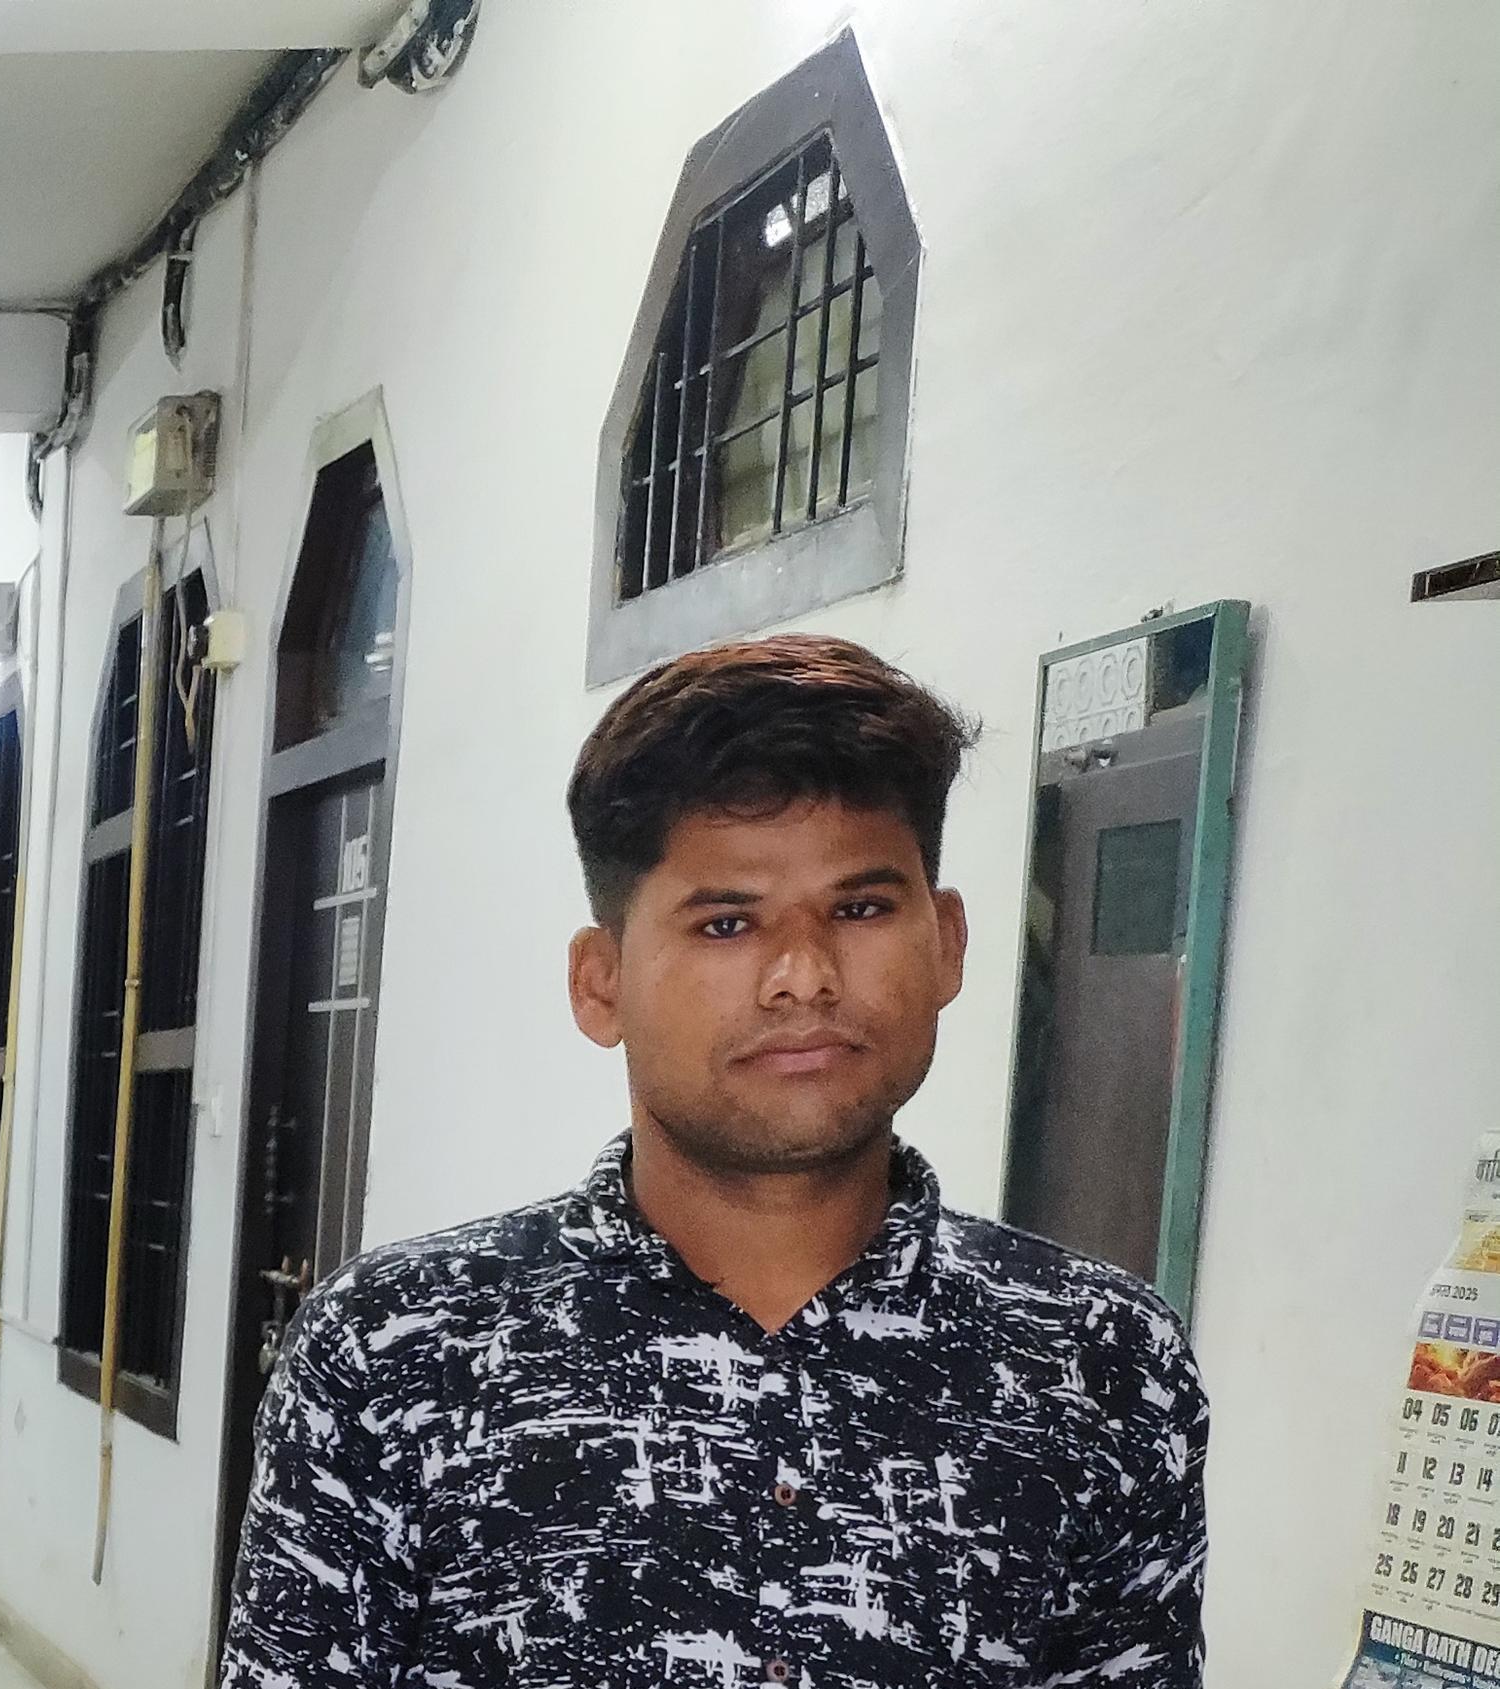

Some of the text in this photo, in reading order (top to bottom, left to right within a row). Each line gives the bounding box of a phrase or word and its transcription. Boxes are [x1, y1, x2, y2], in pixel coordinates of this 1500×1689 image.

[1402, 1397, 1422, 1422] 04
[1432, 1402, 1452, 1427] 05
[1460, 1407, 1479, 1431] 06
[1396, 1451, 1493, 1492] 11 12 13 14
[1386, 1502, 1400, 1526] 18
[1411, 1508, 1427, 1533] 19
[1436, 1515, 1455, 1539] 20
[1464, 1522, 1480, 1547] 21
[1374, 1553, 1393, 1577] 25
[1400, 1560, 1419, 1584] 26
[1426, 1567, 1446, 1591] 27
[1453, 1573, 1473, 1599] 28
[1369, 1615, 1425, 1655] GANGA
[1425, 1631, 1472, 1669] BATH
